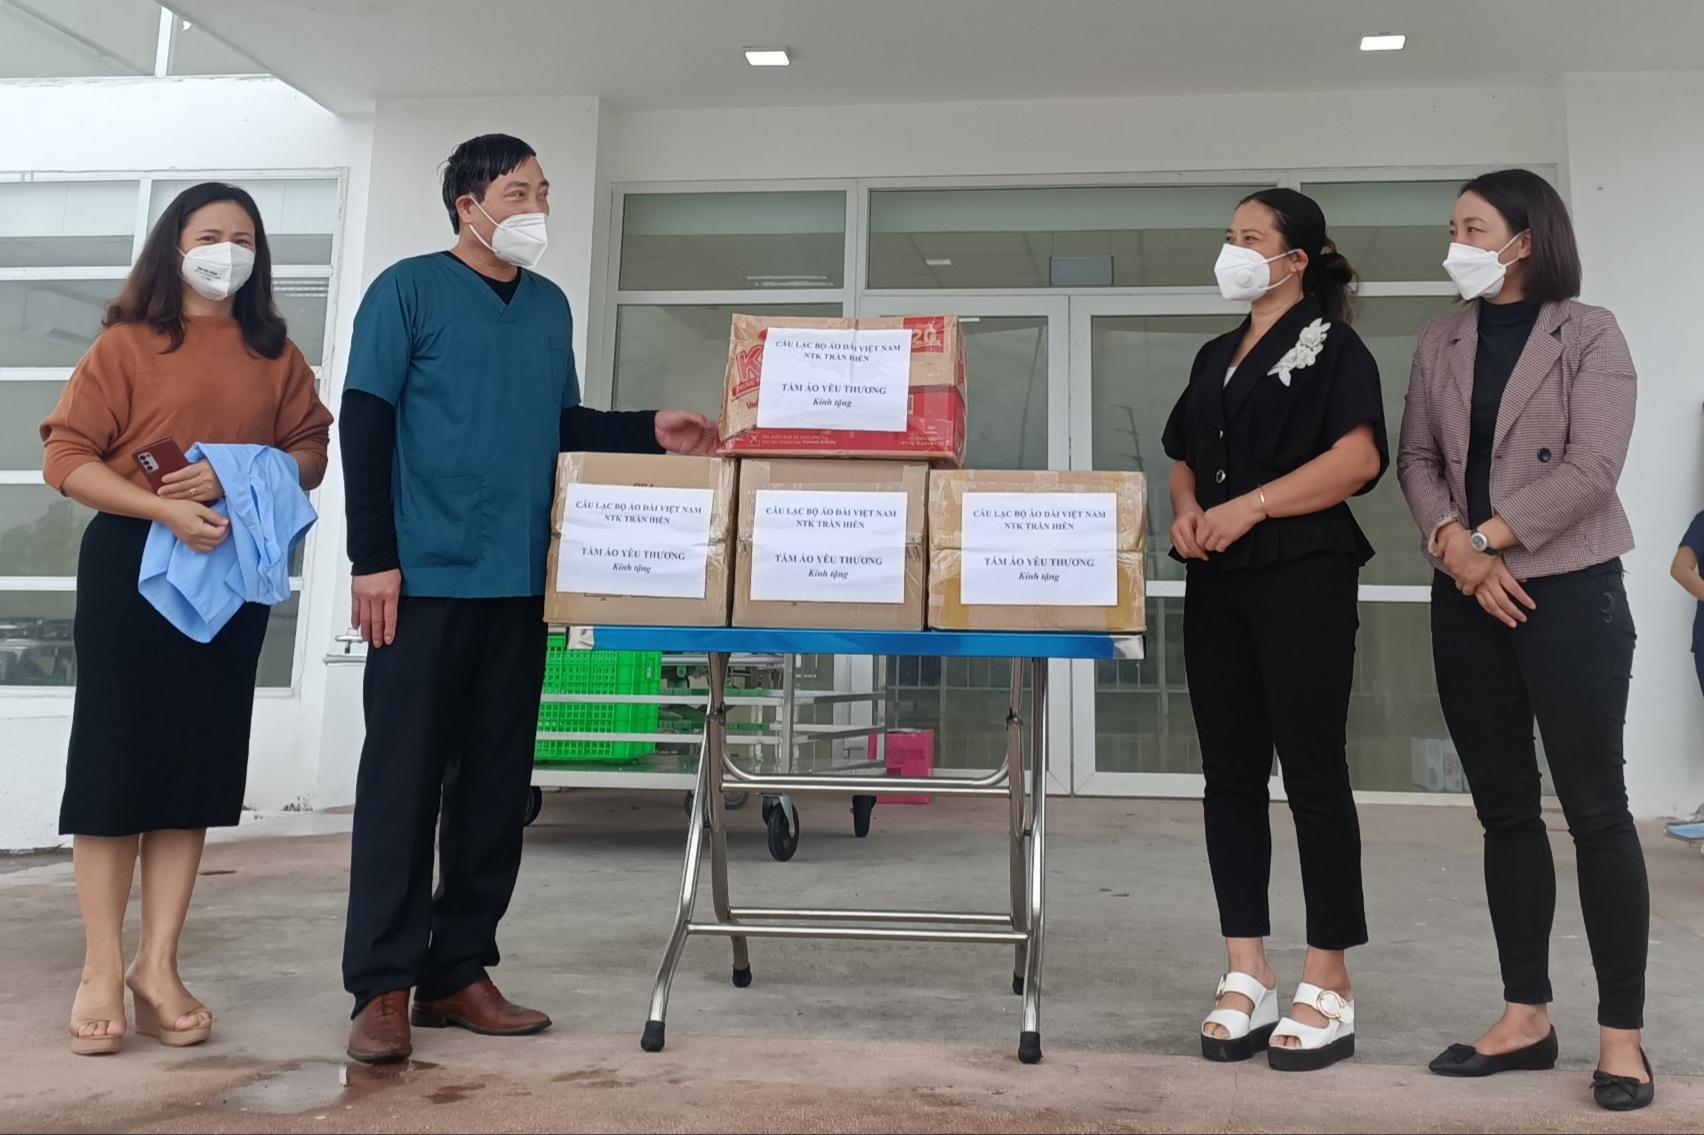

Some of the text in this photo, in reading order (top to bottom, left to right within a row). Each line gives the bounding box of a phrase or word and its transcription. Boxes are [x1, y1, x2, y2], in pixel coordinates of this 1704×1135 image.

[795, 341, 813, 350] LẠC
[828, 341, 841, 350] ÁO
[858, 344, 880, 353] VIỆT
[880, 344, 901, 352] NAM
[803, 352, 822, 360] NTK
[804, 383, 820, 393] ÁO
[822, 383, 842, 394] YÊU
[843, 385, 887, 395] THƯƠNG
[595, 502, 612, 511] LẠC
[628, 502, 641, 511] ÁO
[660, 505, 681, 514] VIỆT
[681, 506, 702, 514] NAM
[786, 508, 804, 517] LẠC
[820, 507, 834, 516] ÁO
[853, 509, 875, 518] VIỆT
[603, 514, 623, 522] NTK
[994, 510, 1013, 519] LẠC
[1028, 508, 1042, 518] ÁO
[1061, 510, 1083, 520] VIỆT
[796, 520, 815, 528] NTK
[1004, 522, 1023, 530] NTK
[604, 547, 619, 557] ÁO
[621, 548, 641, 559] YÊU
[643, 550, 686, 561] THƯƠNG
[799, 554, 814, 563] ÁO
[816, 554, 836, 564] YÊU
[838, 555, 883, 565] THƯƠNG
[1009, 556, 1024, 566] ÁO
[1026, 556, 1048, 566] YÊU
[1049, 558, 1095, 567] THƯƠNG
